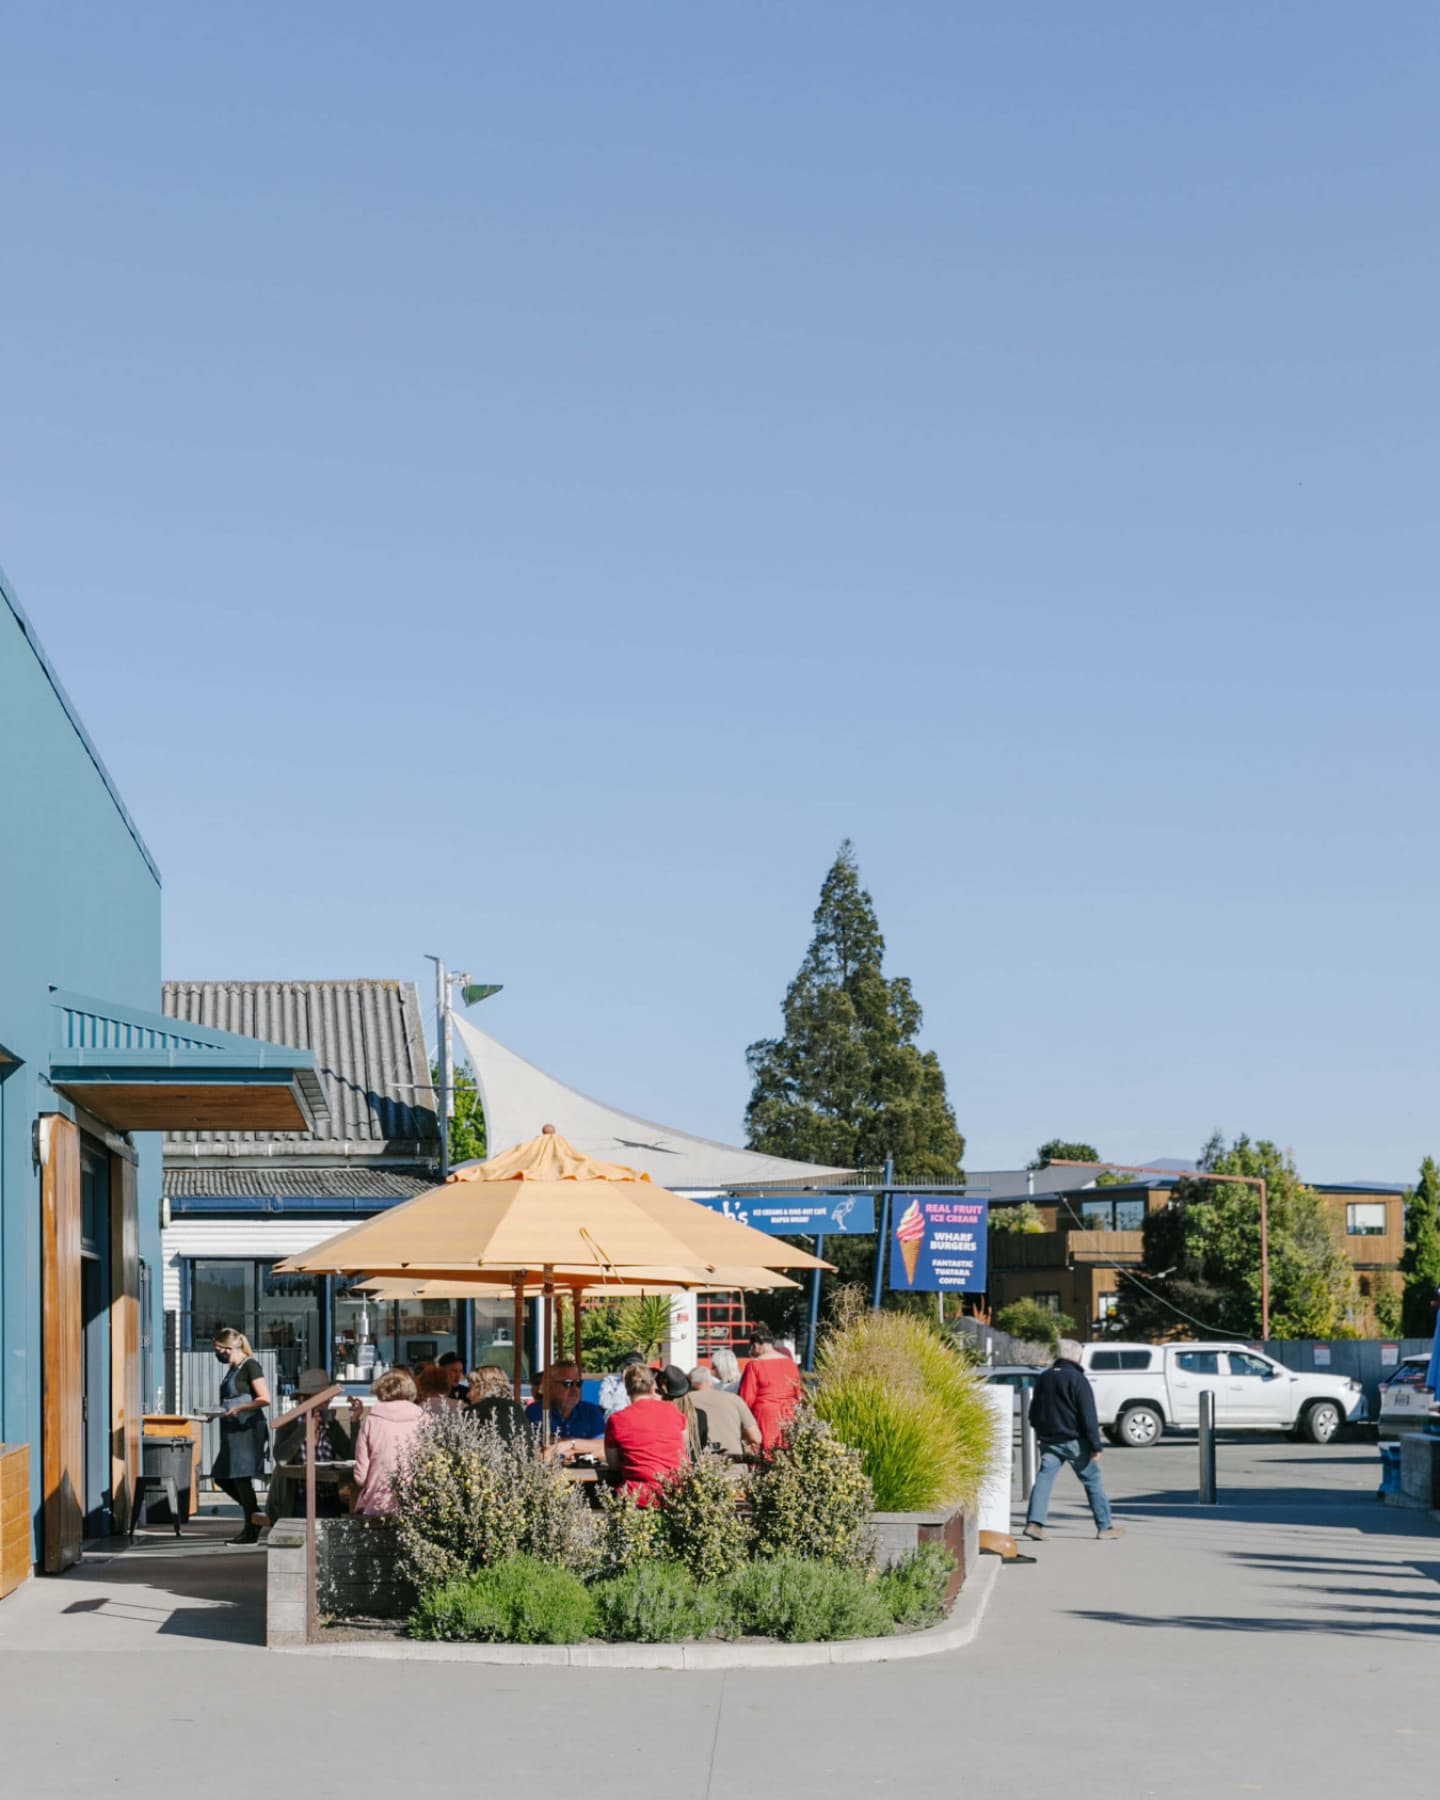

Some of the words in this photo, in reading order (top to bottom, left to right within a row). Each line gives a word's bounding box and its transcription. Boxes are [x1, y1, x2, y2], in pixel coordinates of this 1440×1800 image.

[925, 1203, 951, 1214] REAL
[953, 1204, 983, 1215] FRUIT
[930, 1214, 945, 1223] ICE
[946, 1214, 978, 1224] CREAM
[934, 1232, 973, 1242] WHARF
[930, 1240, 977, 1251] BURGERS
[932, 1259, 974, 1268] FANTASTIC
[939, 1276, 966, 1285] COFFEE
